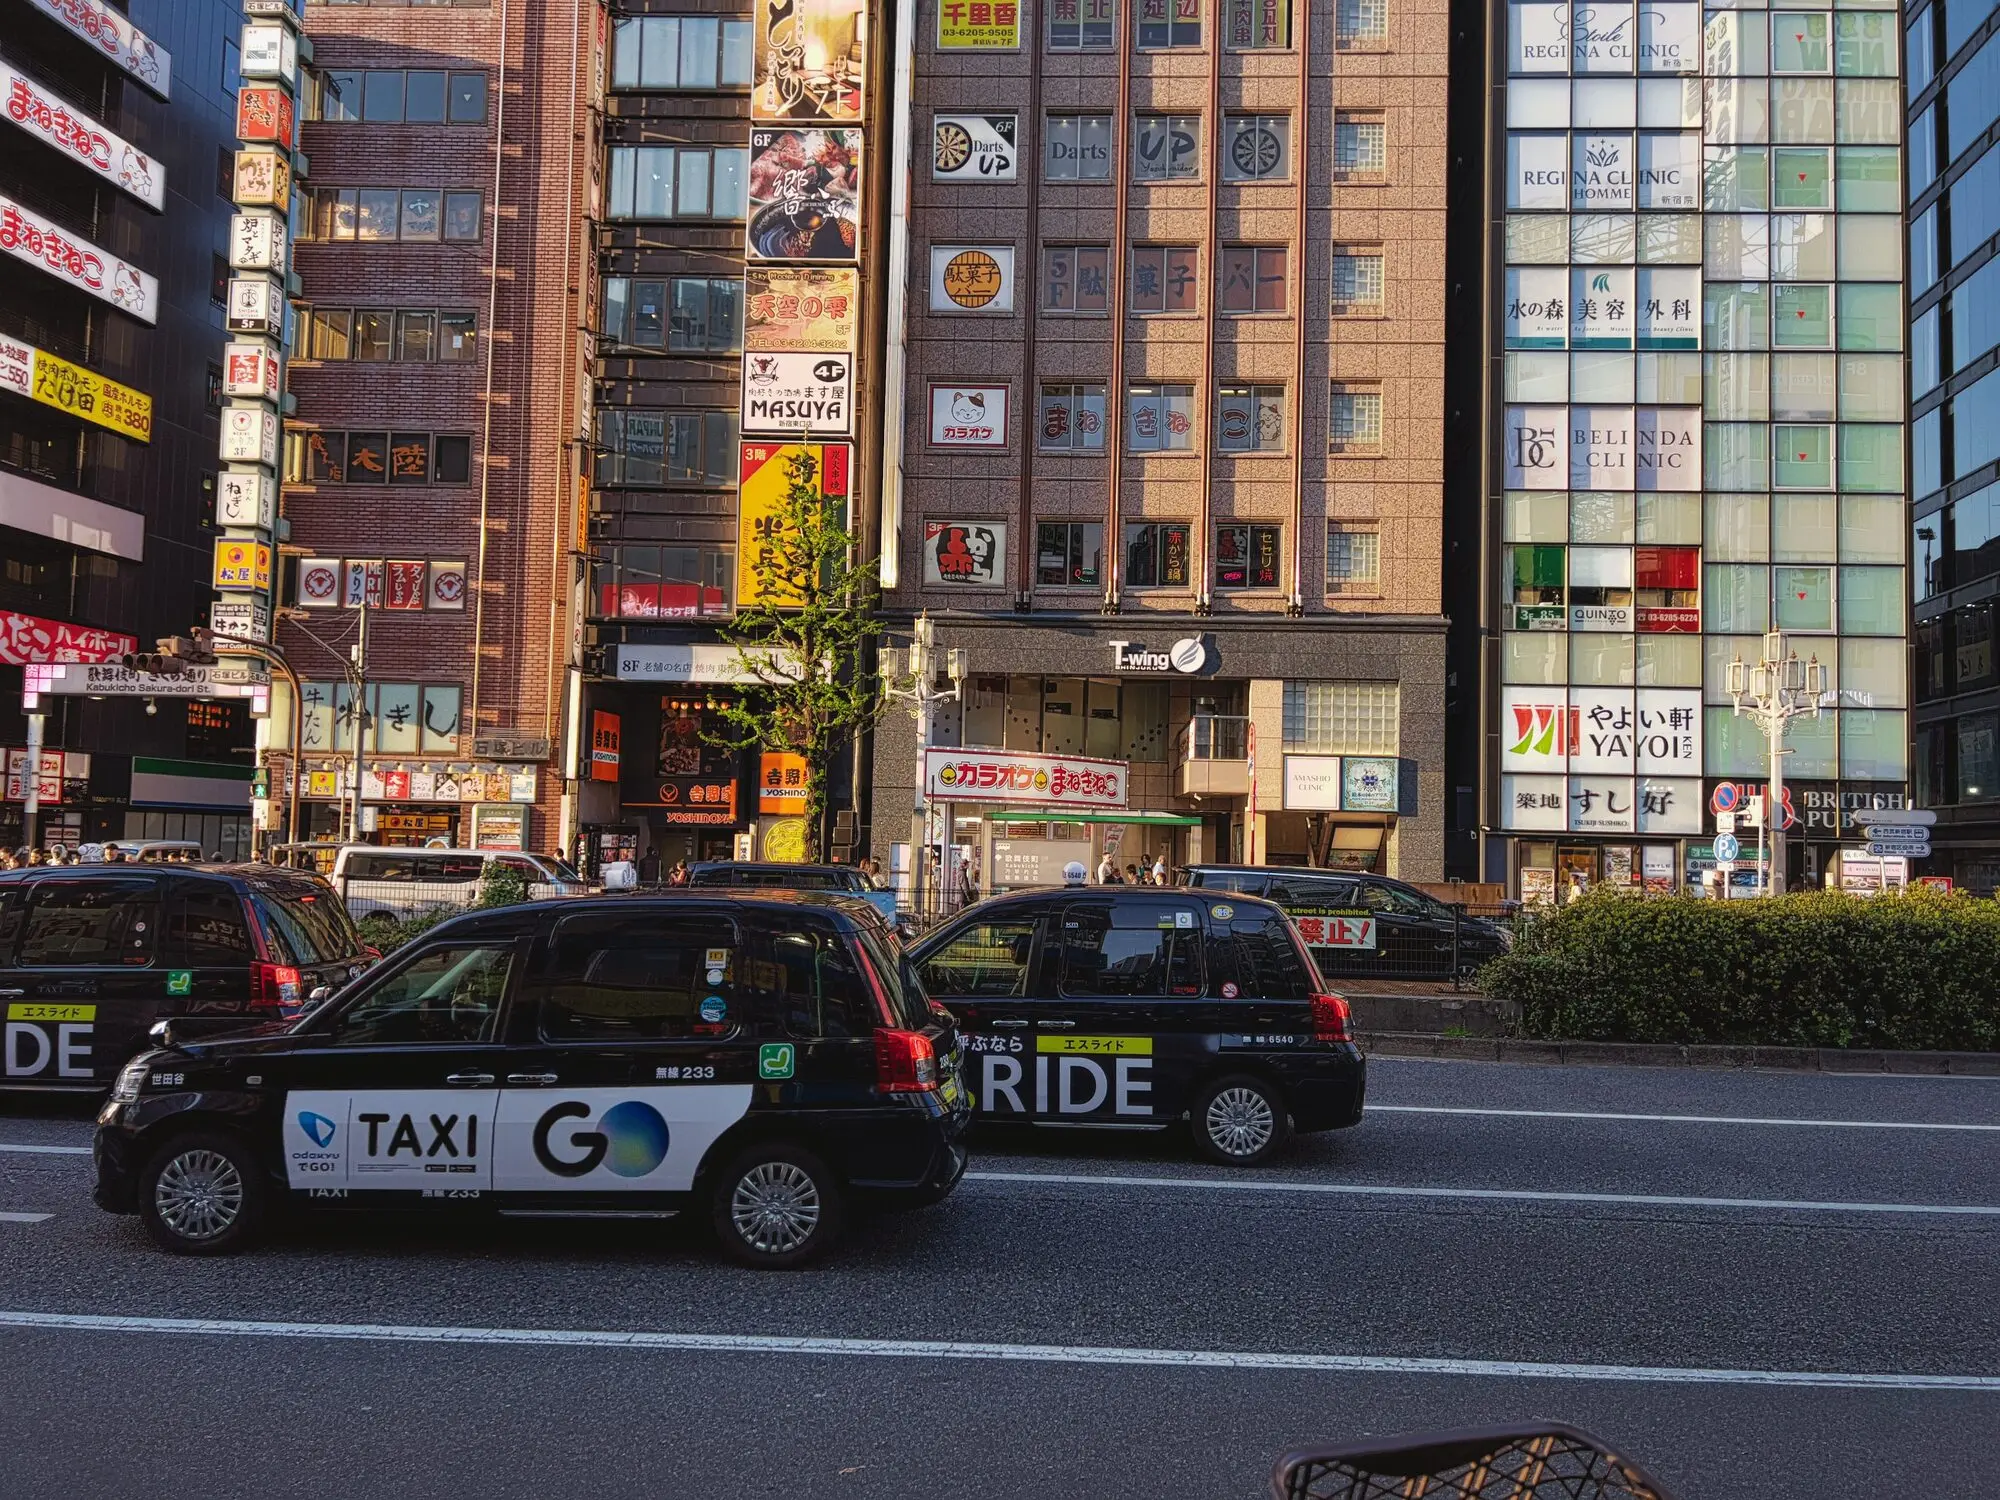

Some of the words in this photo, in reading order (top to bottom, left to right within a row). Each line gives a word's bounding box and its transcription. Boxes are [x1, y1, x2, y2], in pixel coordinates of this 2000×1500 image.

[247, 2, 281, 10] 石塚ビル
[943, 2, 1017, 26] 千里香
[1524, 45, 1600, 58] REGINA
[1609, 44, 1680, 57] CLINIC
[813, 89, 853, 114] 7F
[6, 77, 112, 171] まねきねこ
[995, 121, 1014, 133] 6F
[753, 134, 772, 146] 6F
[974, 140, 1004, 153] Darts
[1052, 142, 1107, 160] Darts
[1140, 131, 1196, 162] UP
[979, 154, 1010, 175] UP
[1524, 172, 1600, 185] REGINA
[1607, 171, 1680, 185] CLINIC
[1574, 188, 1631, 199] HOMME
[0, 205, 105, 290] まねきねこ
[749, 272, 767, 281] Sky
[945, 265, 1000, 282] 駄菓子
[1050, 253, 1068, 306] 5F
[955, 287, 991, 295] バー
[751, 294, 849, 319] 天空の雫
[1507, 298, 1693, 321] 水の森美容外科
[241, 319, 255, 328] 5F
[836, 325, 851, 335] 5F
[8, 366, 29, 387] 550
[36, 357, 101, 392] 焼肉ホルモン
[815, 366, 844, 378] 4F
[37, 375, 96, 414] たけ田
[102, 383, 151, 411] 国産ホルモン
[804, 386, 844, 399] ます屋
[751, 400, 842, 420] MASUYA
[123, 408, 150, 433] 380
[1042, 403, 1250, 441] まねきねこ
[942, 426, 995, 440] カラオケ
[1573, 430, 1694, 446] BELINDA
[234, 447, 247, 456] 3F
[745, 449, 767, 461] 3階
[351, 444, 427, 476] 大陸
[1586, 452, 1682, 468] CLINIC
[830, 451, 842, 491] 炭火串焼
[225, 482, 242, 519] ねぎし
[928, 523, 943, 531] 3F
[1167, 531, 1182, 581] 赤から鍋
[1260, 531, 1274, 582] セセリ焼
[220, 566, 250, 580] 松屋
[349, 563, 364, 606] めり乃
[1575, 608, 1627, 622] QUINTO
[215, 618, 249, 632] 牛かつ
[55, 625, 134, 655] ハイボール
[1109, 641, 1170, 671] T-wing
[622, 660, 640, 672] 8F
[643, 662, 693, 673] 老舗の名店
[213, 671, 247, 679] 石塚ビル
[86, 683, 136, 692] Kabukicho
[138, 683, 195, 692] Sakura-dori
[197, 684, 211, 692] St.
[303, 688, 325, 745] 牛たん
[1587, 704, 1694, 731] やよい軒
[595, 728, 618, 750] 吉野家
[1589, 734, 1679, 759] YAYOI
[1682, 735, 1693, 759] KEN
[475, 740, 545, 756] 石塚ビル
[593, 751, 618, 762] YOSHINOYA
[957, 762, 1035, 789] カラオケ
[1050, 765, 1119, 798] まねきねこ
[314, 785, 330, 793] 松屋
[1516, 792, 1562, 809] 築地
[1571, 789, 1674, 815] すし好
[1807, 791, 1904, 809] BRITISH
[403, 817, 424, 828] 松屋
[667, 812, 734, 824] YOSHINOYA
[1807, 811, 1855, 828] PUB
[1718, 839, 1729, 858] P
[1067, 871, 1082, 879] 6540
[1292, 907, 1314, 917] street
[1316, 907, 1324, 917] is
[1327, 907, 1371, 919] prohibited.
[1065, 921, 1079, 929] km
[23, 1007, 81, 1018] エスライド
[1063, 1039, 1126, 1052] エスライド
[1269, 1035, 1294, 1044] 6540
[152, 1073, 185, 1085] 世田谷
[655, 1067, 680, 1079] 無線
[682, 1067, 715, 1079] 233
[982, 1056, 1153, 1115] RIDE
[358, 1113, 478, 1158] TAXI
[532, 1101, 671, 1179] GO
[292, 1152, 340, 1160] odakyu
[298, 1163, 336, 1173] でGO!
